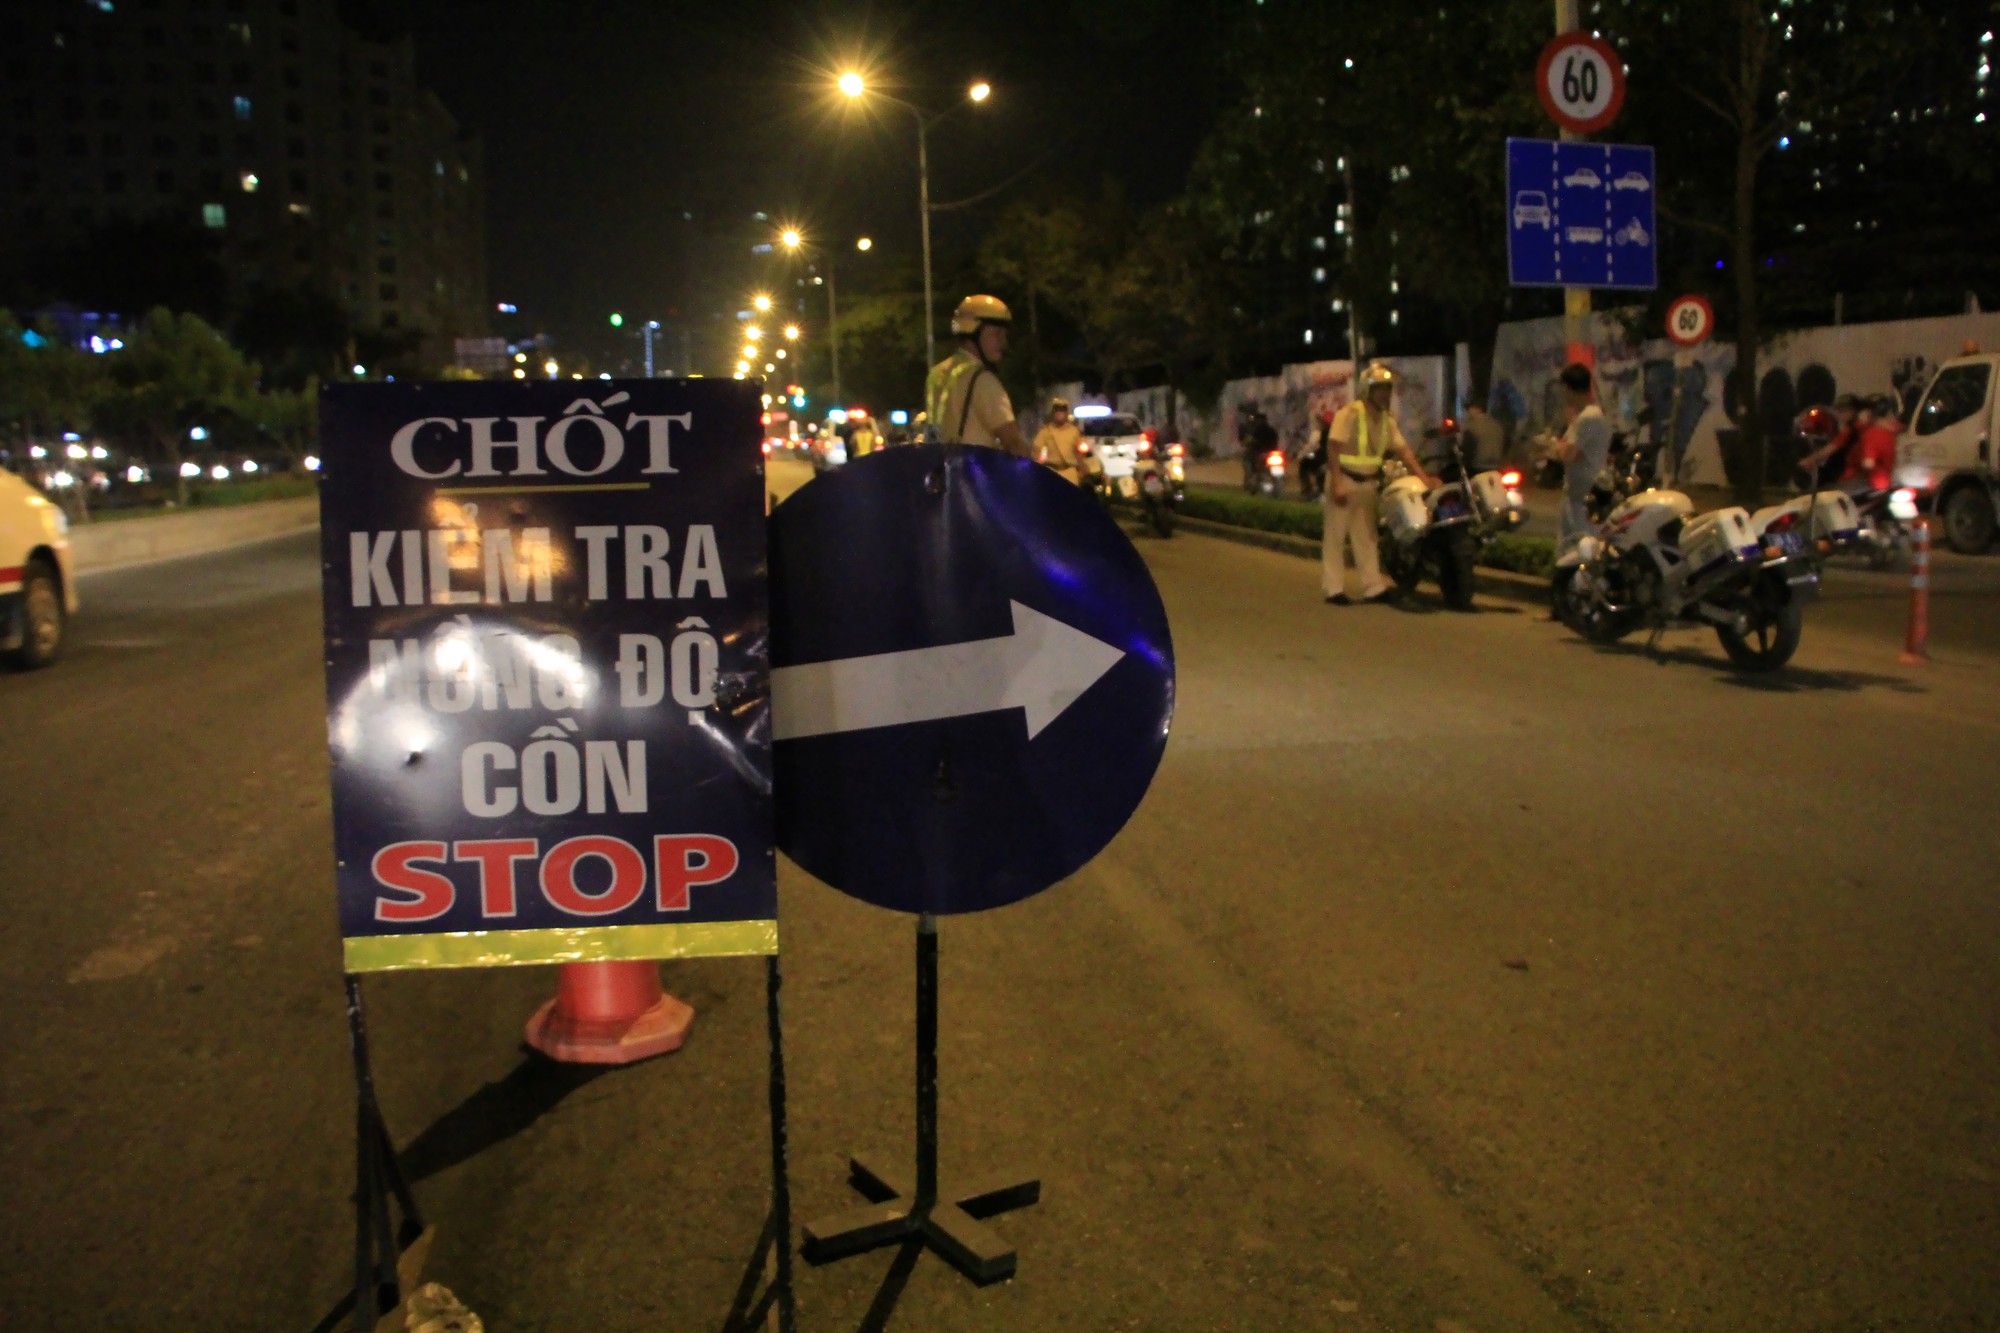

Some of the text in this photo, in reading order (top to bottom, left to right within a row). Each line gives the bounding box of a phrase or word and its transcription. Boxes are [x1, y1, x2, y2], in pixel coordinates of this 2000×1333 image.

[1562, 55, 1598, 104] 60
[1679, 308, 1698, 331] 60
[390, 391, 692, 479] CHỐT
[350, 502, 728, 607] KIỂM TRA
[368, 614, 719, 725] NỒNG ĐỘ
[461, 717, 648, 818] CỒN
[371, 833, 740, 923] STOP
